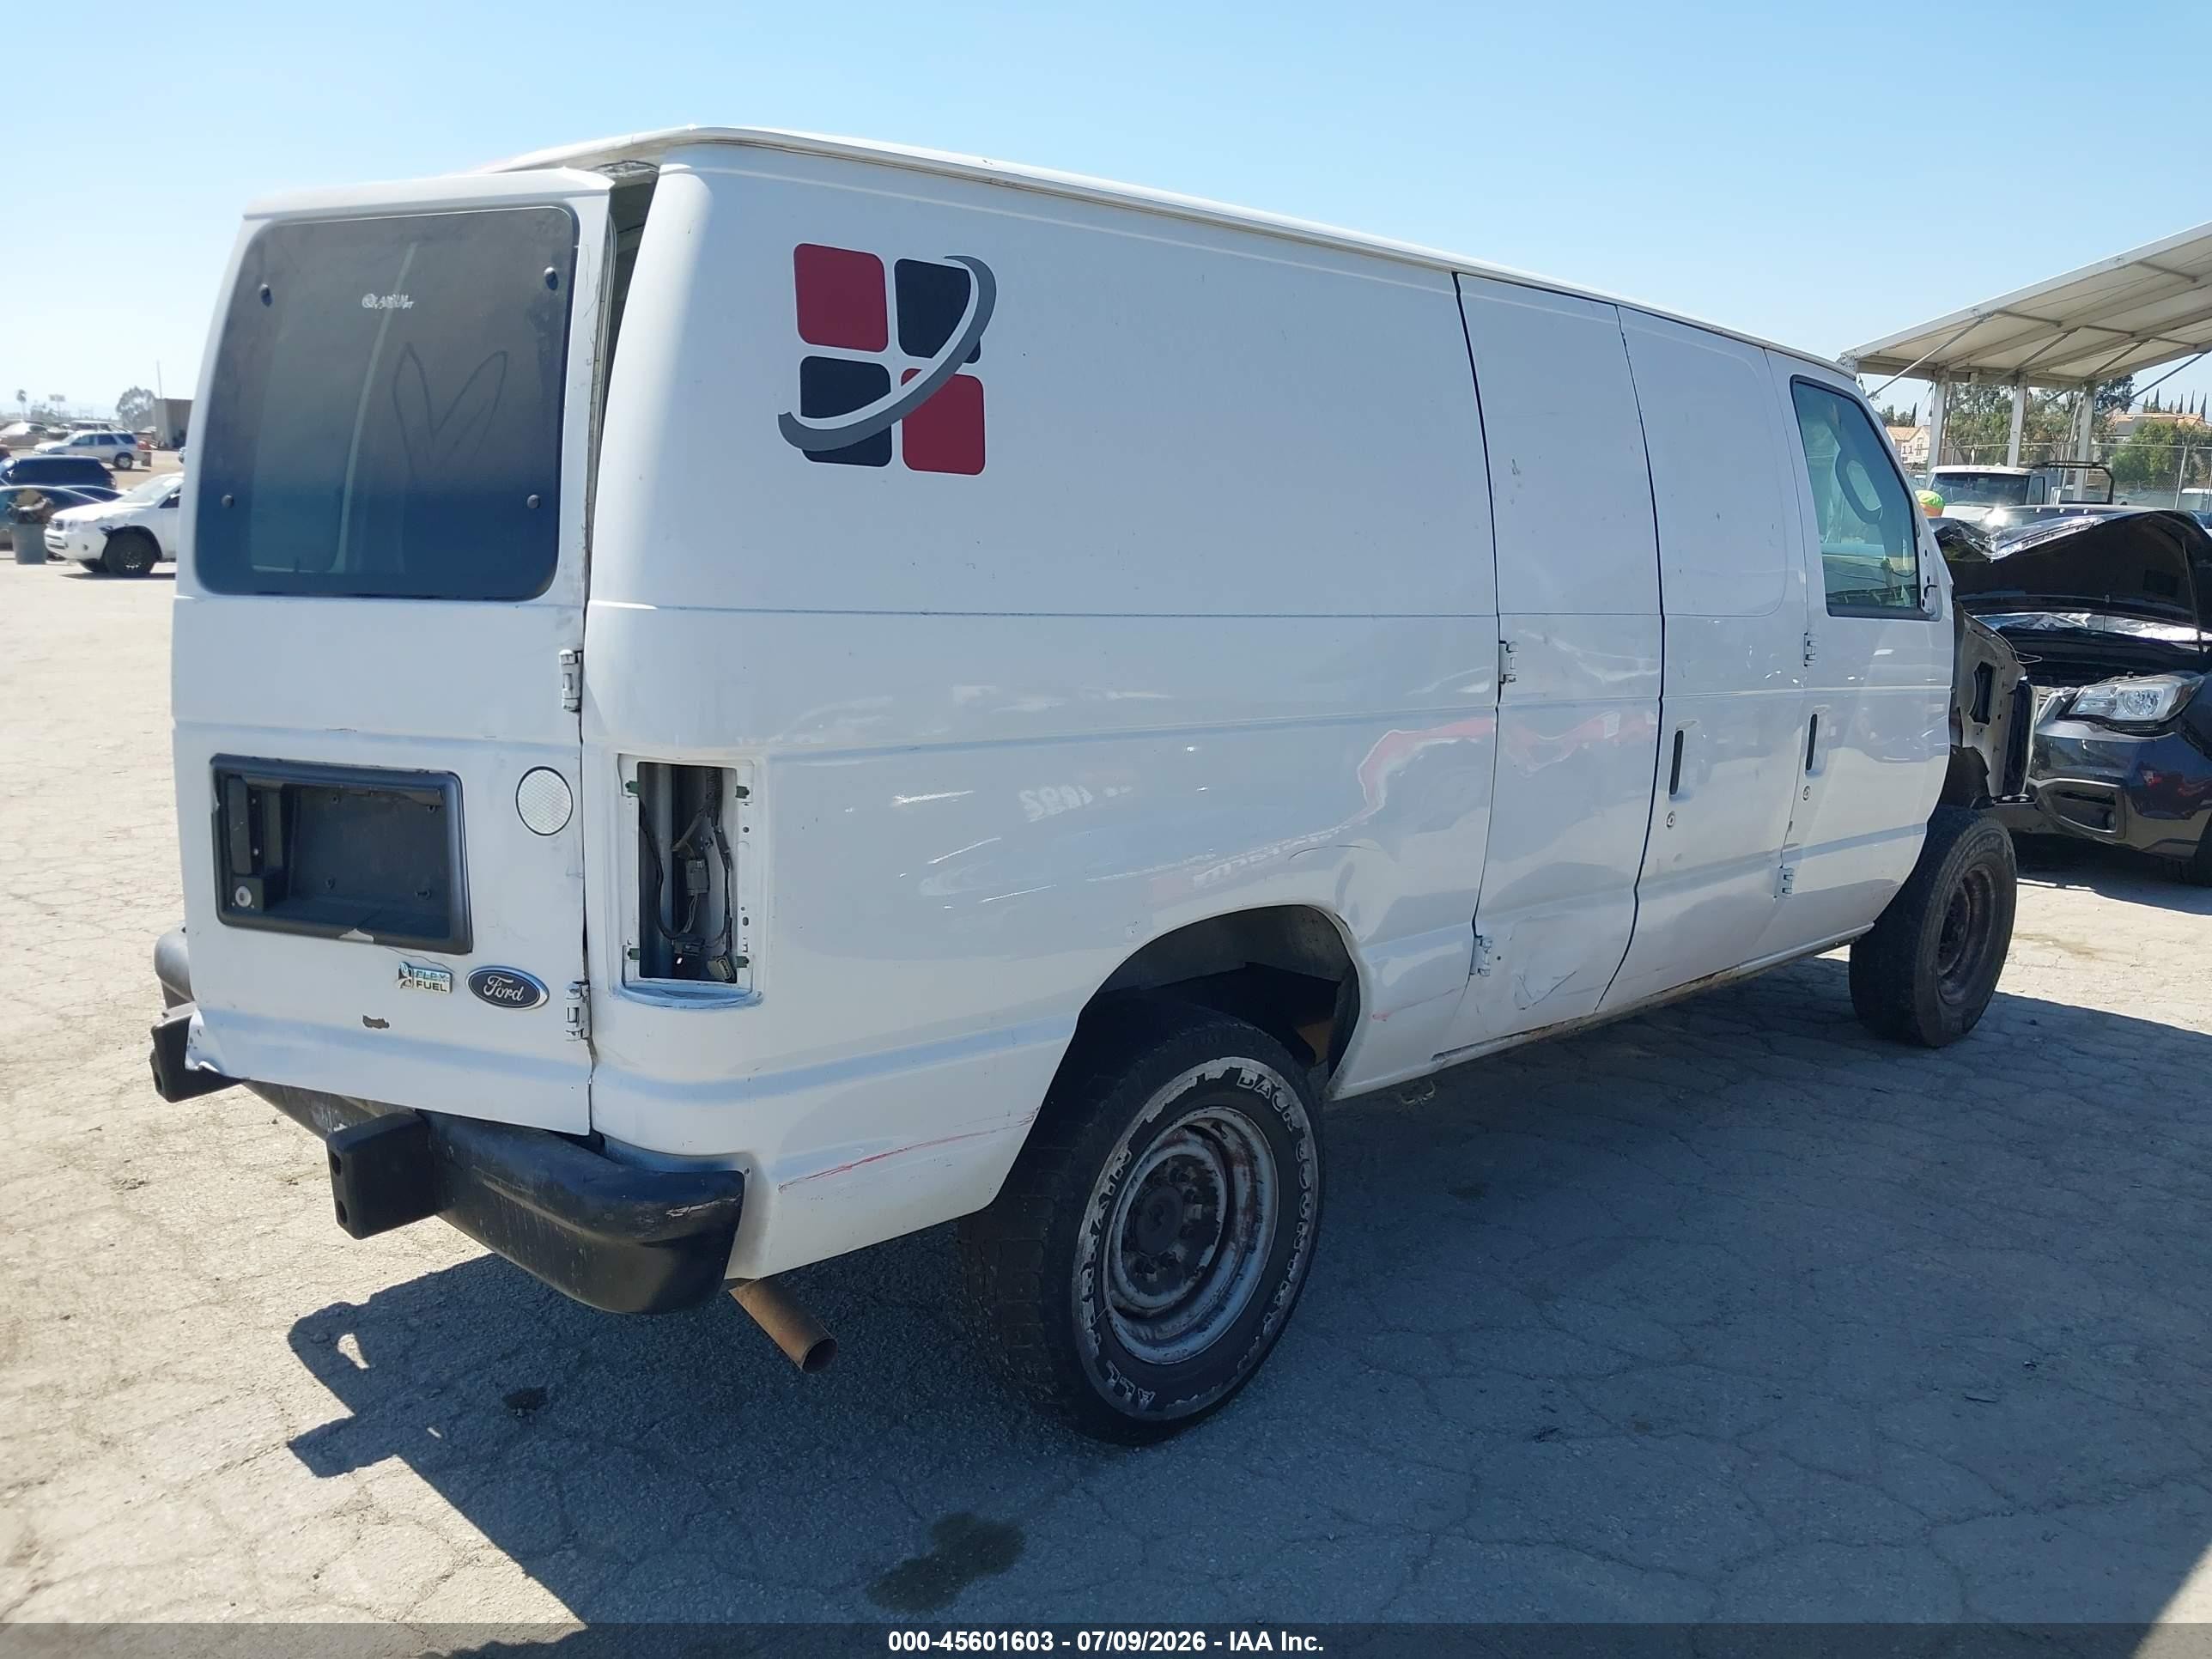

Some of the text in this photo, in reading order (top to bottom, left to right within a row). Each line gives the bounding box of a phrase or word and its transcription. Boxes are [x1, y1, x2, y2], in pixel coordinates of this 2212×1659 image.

[416, 970, 447, 982] FLEX
[416, 980, 447, 992] FUEL
[483, 975, 524, 1001] Ford
[1101, 1359, 1156, 1409] ALL
